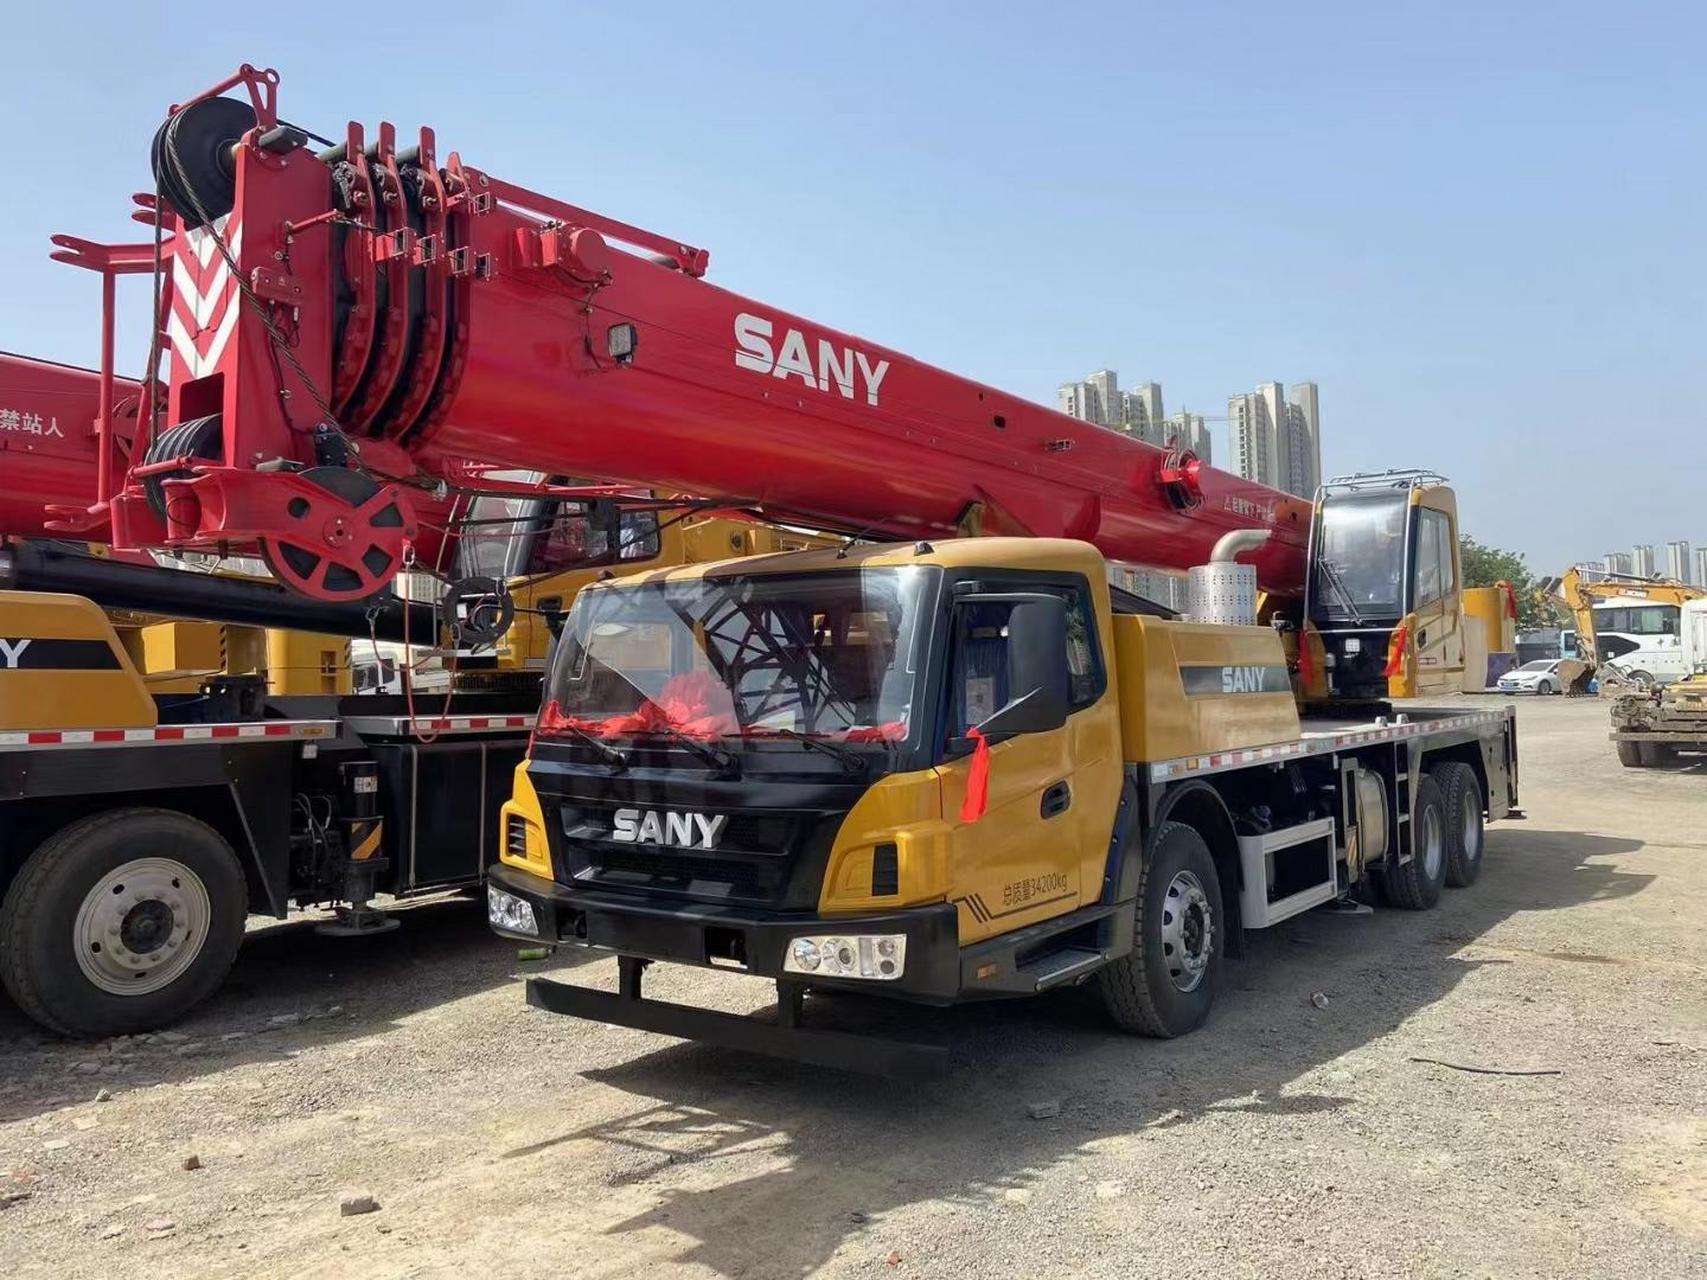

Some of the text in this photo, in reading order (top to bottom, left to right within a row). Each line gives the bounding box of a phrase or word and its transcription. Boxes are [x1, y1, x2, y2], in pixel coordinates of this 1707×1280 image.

[734, 312, 890, 407] SANY
[1222, 666, 1266, 693] SANY
[613, 808, 726, 849] SANY
